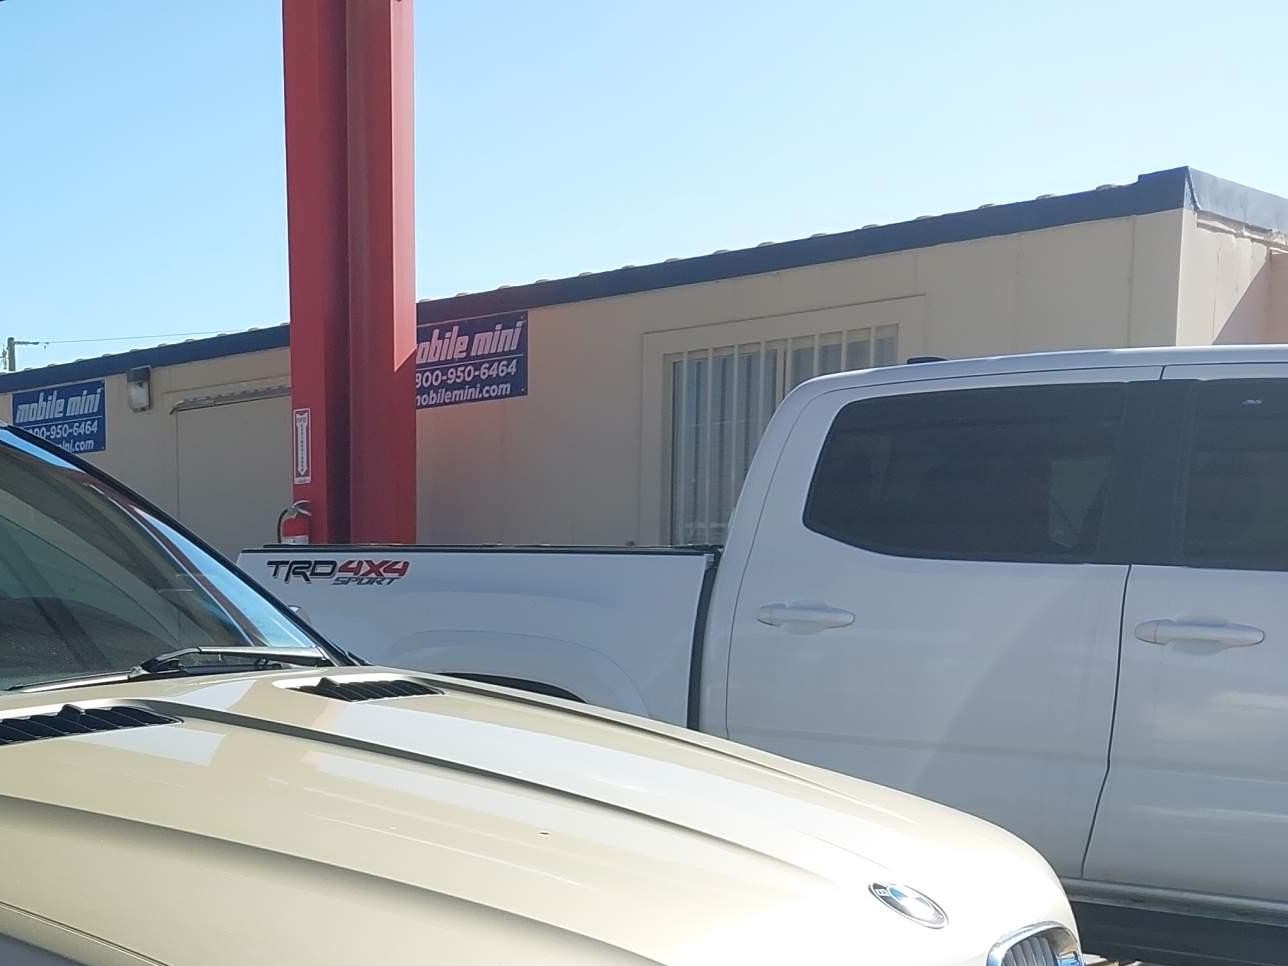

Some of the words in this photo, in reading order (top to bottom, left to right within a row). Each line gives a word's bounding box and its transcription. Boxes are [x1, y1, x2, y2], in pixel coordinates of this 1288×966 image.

[416, 325, 469, 364] obile
[470, 321, 523, 356] mini
[16, 390, 66, 423] mobile
[66, 388, 101, 416] mini
[29, 420, 98, 439] 00-950-6464
[267, 560, 337, 584] TRD
[332, 577, 400, 585] SPORT
